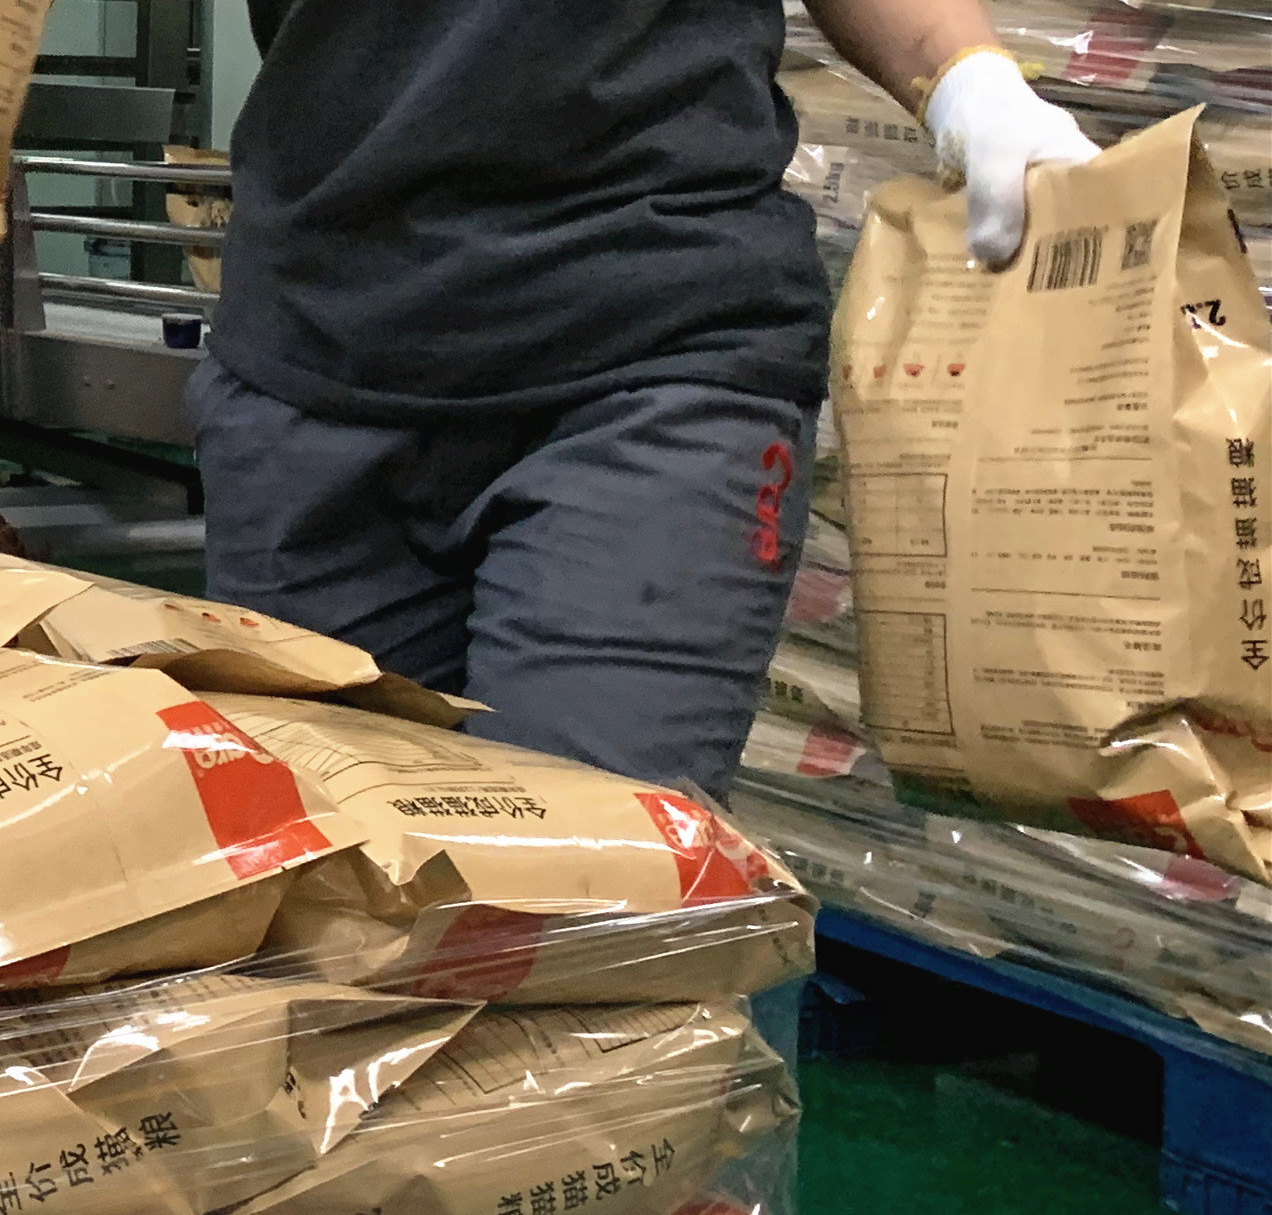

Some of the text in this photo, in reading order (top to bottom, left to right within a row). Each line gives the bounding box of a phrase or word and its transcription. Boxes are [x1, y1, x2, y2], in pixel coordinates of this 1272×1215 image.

[1225, 437, 1271, 672] 全价成猫猫粮
